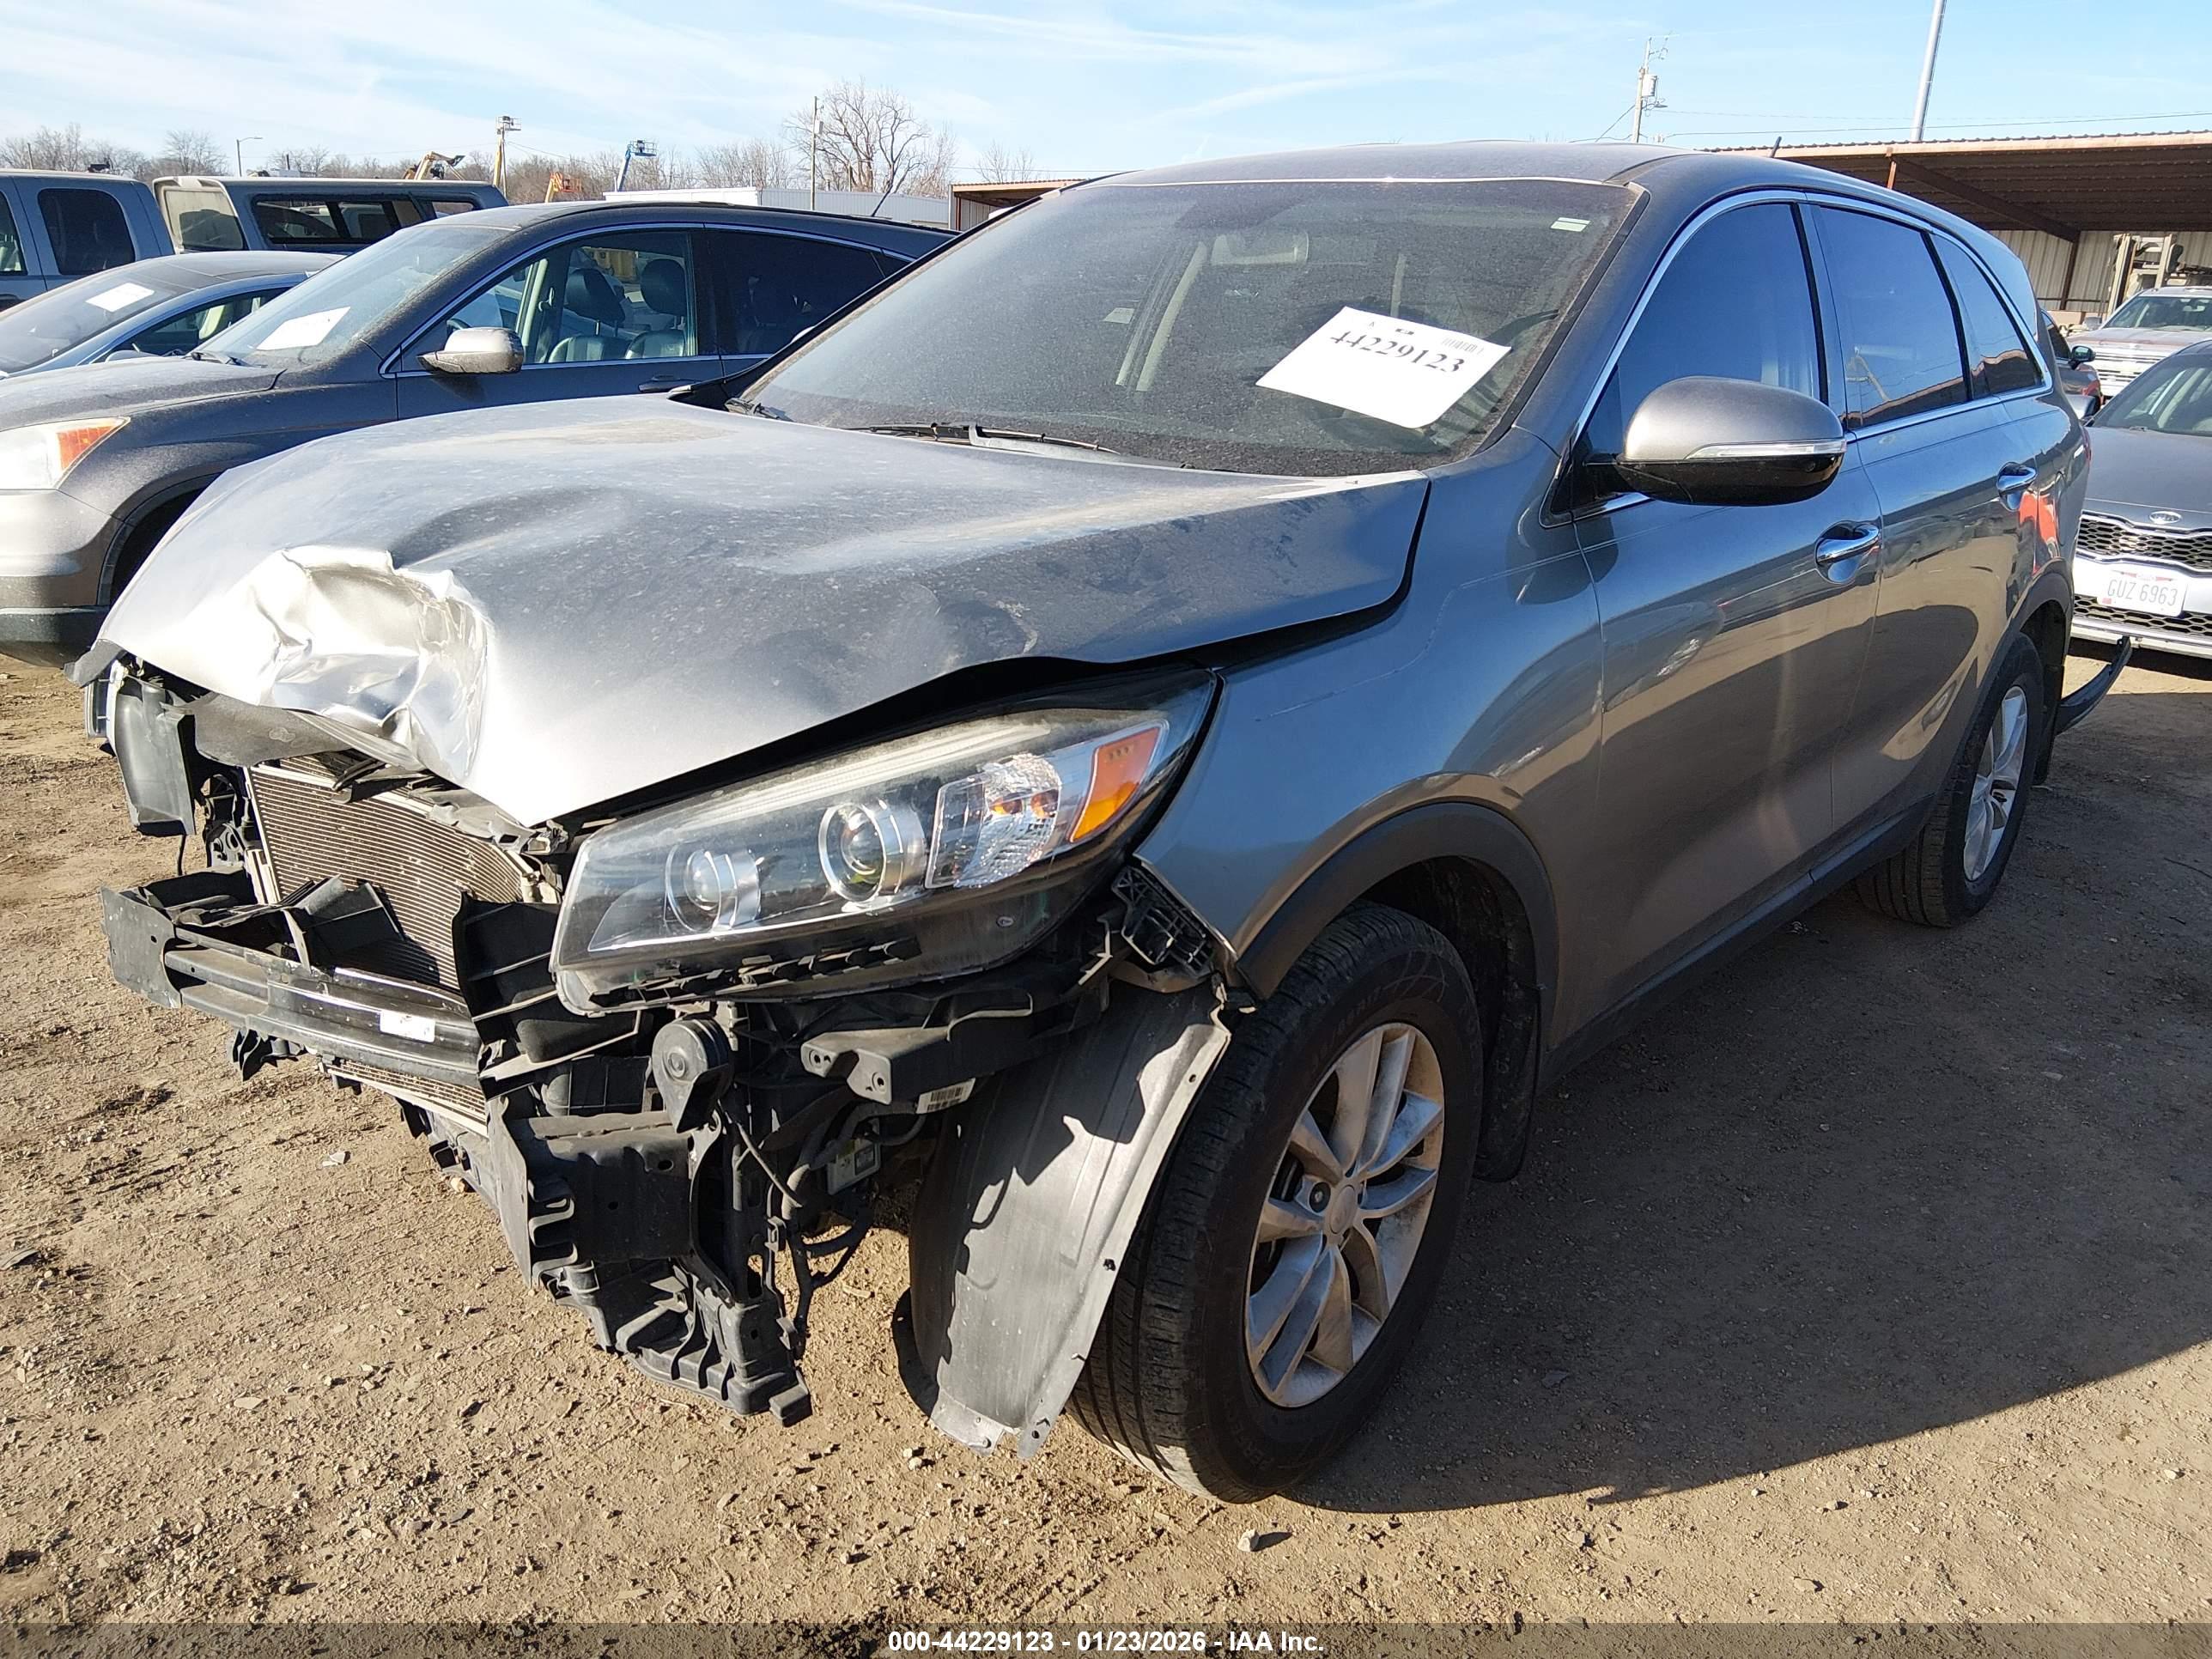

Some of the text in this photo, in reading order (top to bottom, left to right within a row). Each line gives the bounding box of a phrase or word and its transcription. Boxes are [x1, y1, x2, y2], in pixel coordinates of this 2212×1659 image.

[1330, 331, 1465, 373] 44229123
[2107, 580, 2178, 606] GUZ 6963
